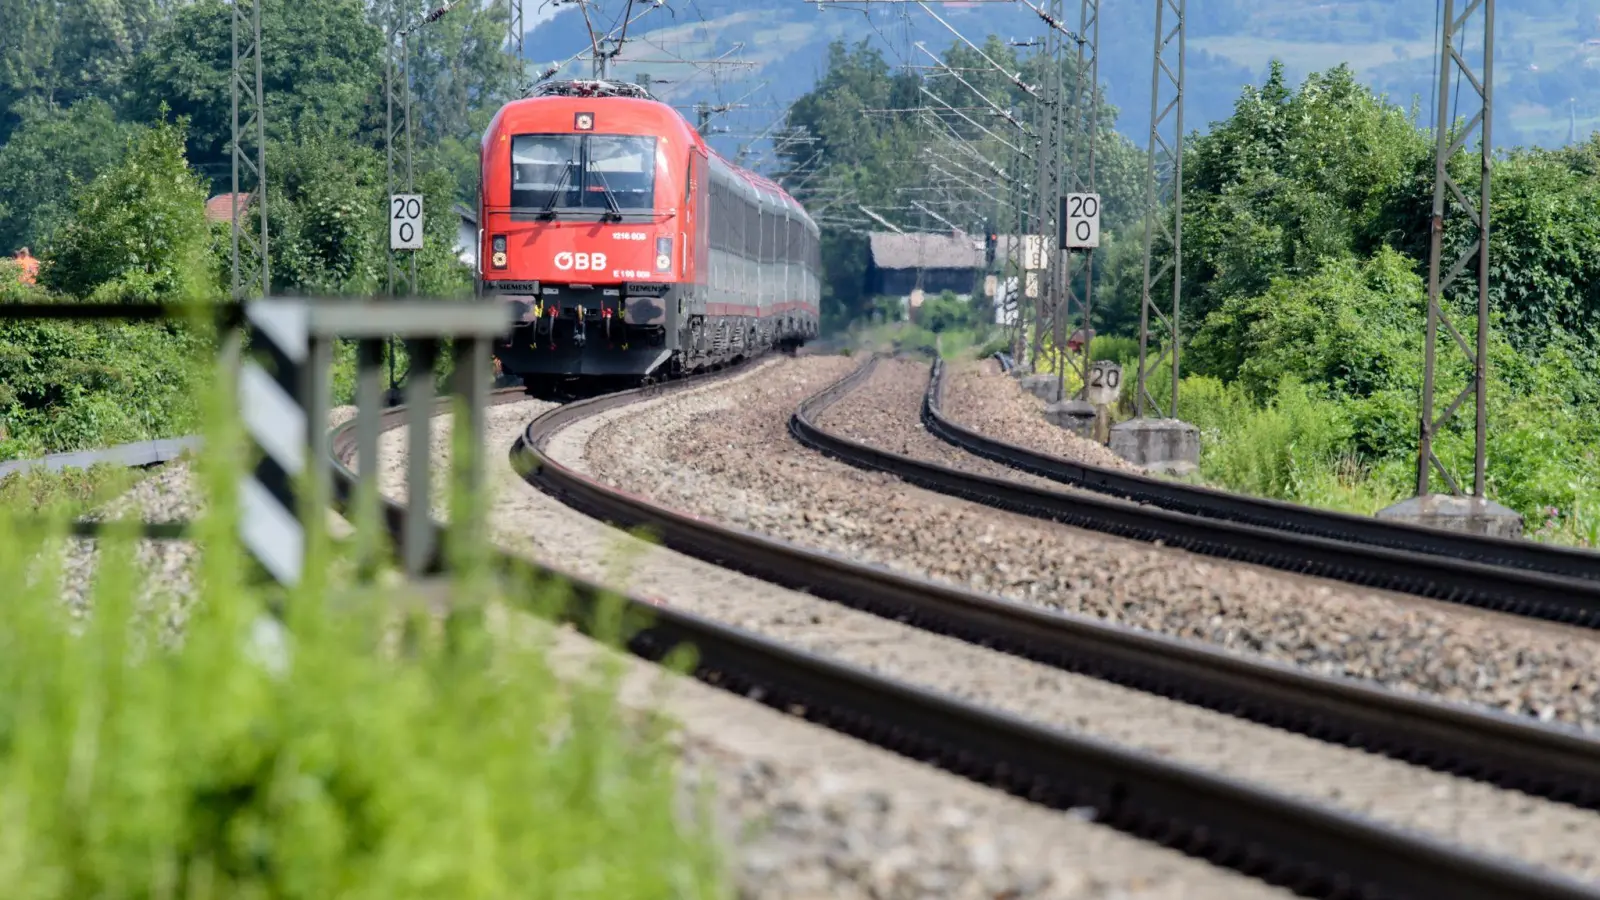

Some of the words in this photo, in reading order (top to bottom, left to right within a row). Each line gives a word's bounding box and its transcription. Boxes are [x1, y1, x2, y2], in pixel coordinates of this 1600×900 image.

[393, 198, 421, 220] 20
[1070, 196, 1098, 218] 20
[399, 222, 414, 242] 0
[1075, 220, 1091, 241] 0
[499, 283, 533, 291] SIEMENS
[1091, 367, 1119, 388] 20
